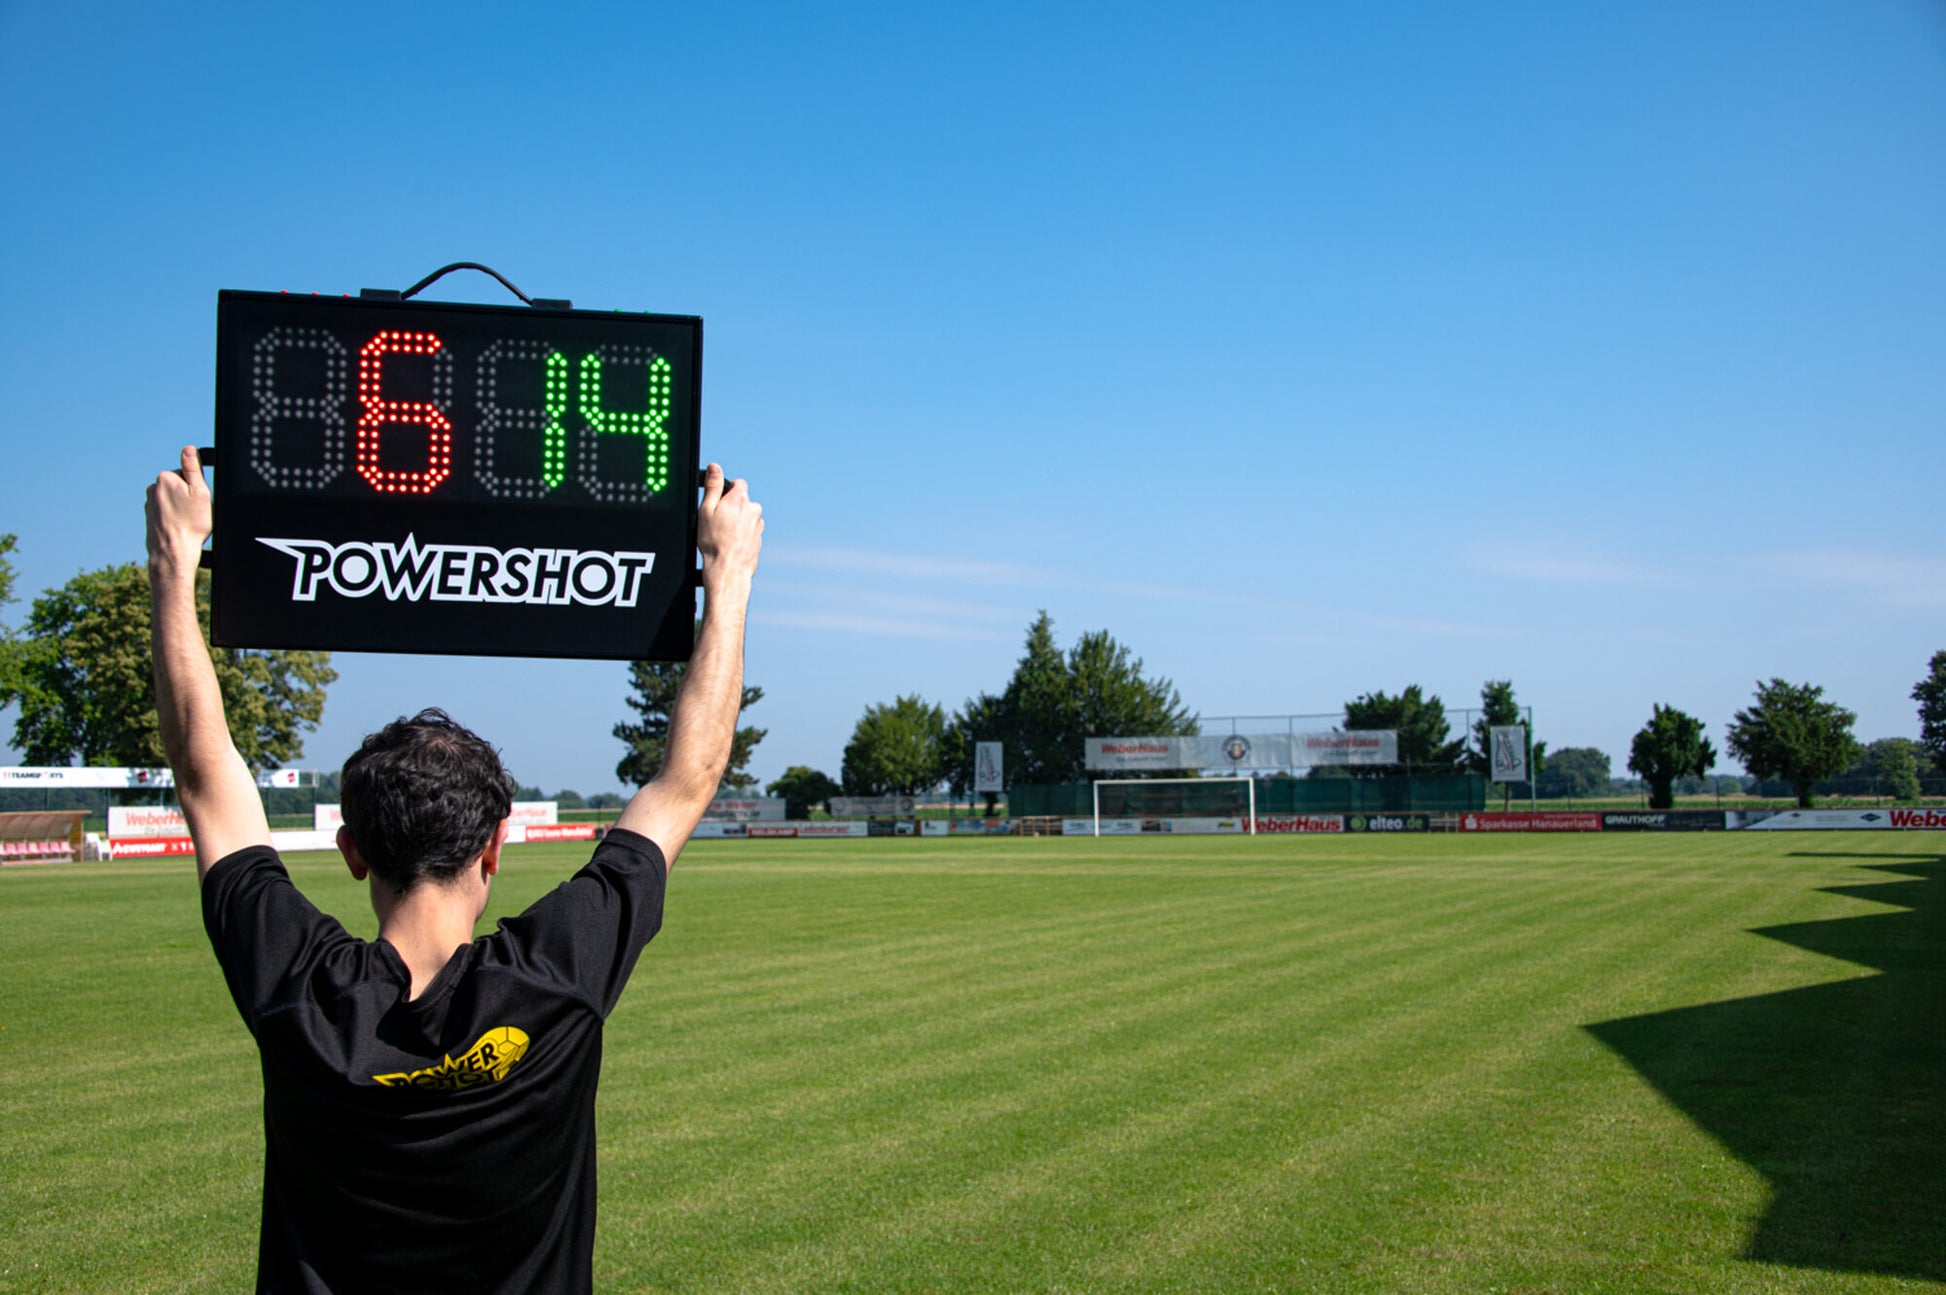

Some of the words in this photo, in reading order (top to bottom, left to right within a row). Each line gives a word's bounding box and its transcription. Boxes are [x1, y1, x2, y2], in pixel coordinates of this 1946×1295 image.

[357, 330, 452, 494] 6
[543, 351, 672, 493] 14
[255, 533, 656, 608] POWERSHOT
[1241, 817, 1341, 832] WeberHaus
[1480, 818, 1530, 830] Sparkasse
[1605, 814, 1666, 825] GRAUTHOFF
